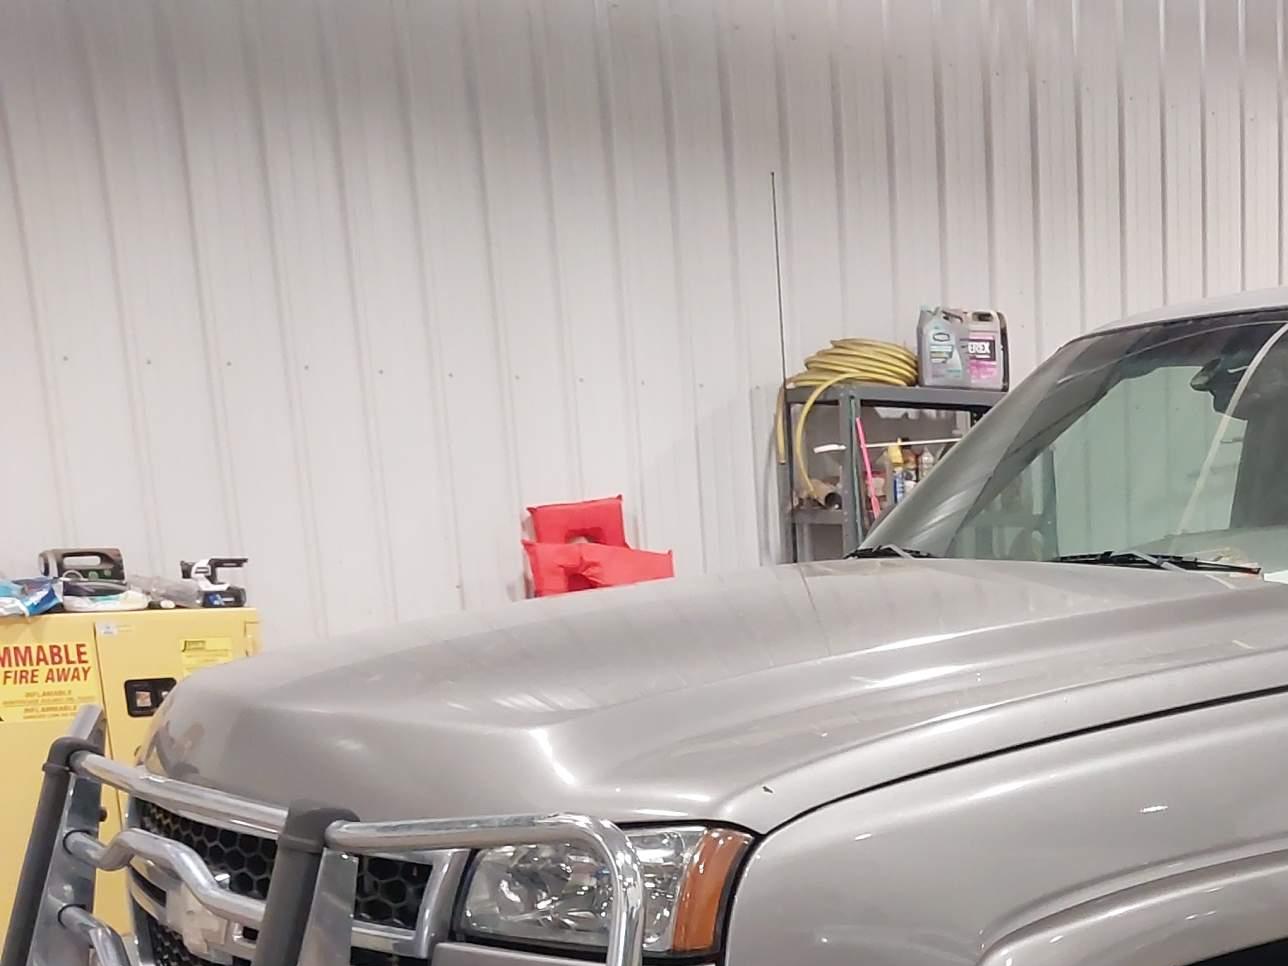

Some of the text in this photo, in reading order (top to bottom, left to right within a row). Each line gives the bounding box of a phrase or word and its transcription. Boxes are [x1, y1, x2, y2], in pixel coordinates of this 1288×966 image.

[963, 341, 991, 355] EREX
[3, 666, 91, 685] FIRE AWAY
